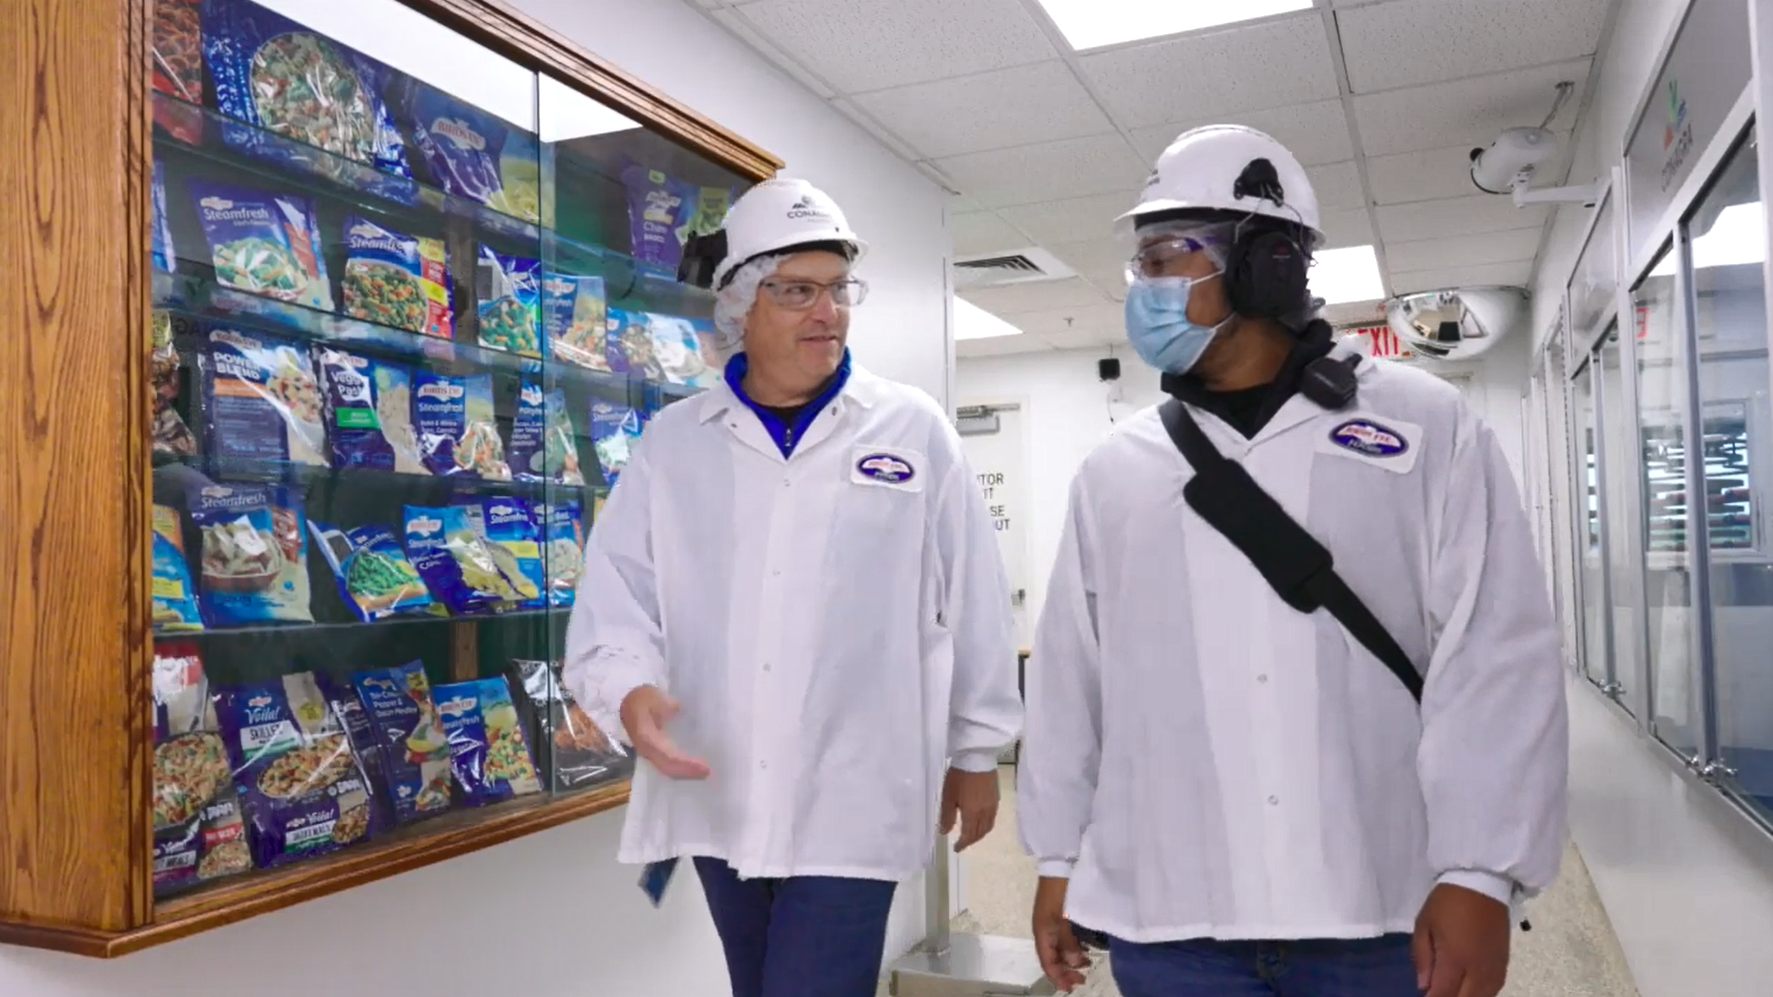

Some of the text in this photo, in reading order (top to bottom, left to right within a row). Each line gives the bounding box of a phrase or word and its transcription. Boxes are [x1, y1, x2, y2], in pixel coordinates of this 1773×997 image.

[438, 121, 467, 139] BIRDS
[204, 207, 269, 221] Steamfresh
[213, 351, 262, 372] POWER
[216, 362, 261, 380] BLEND
[201, 493, 267, 509] Steamfresh
